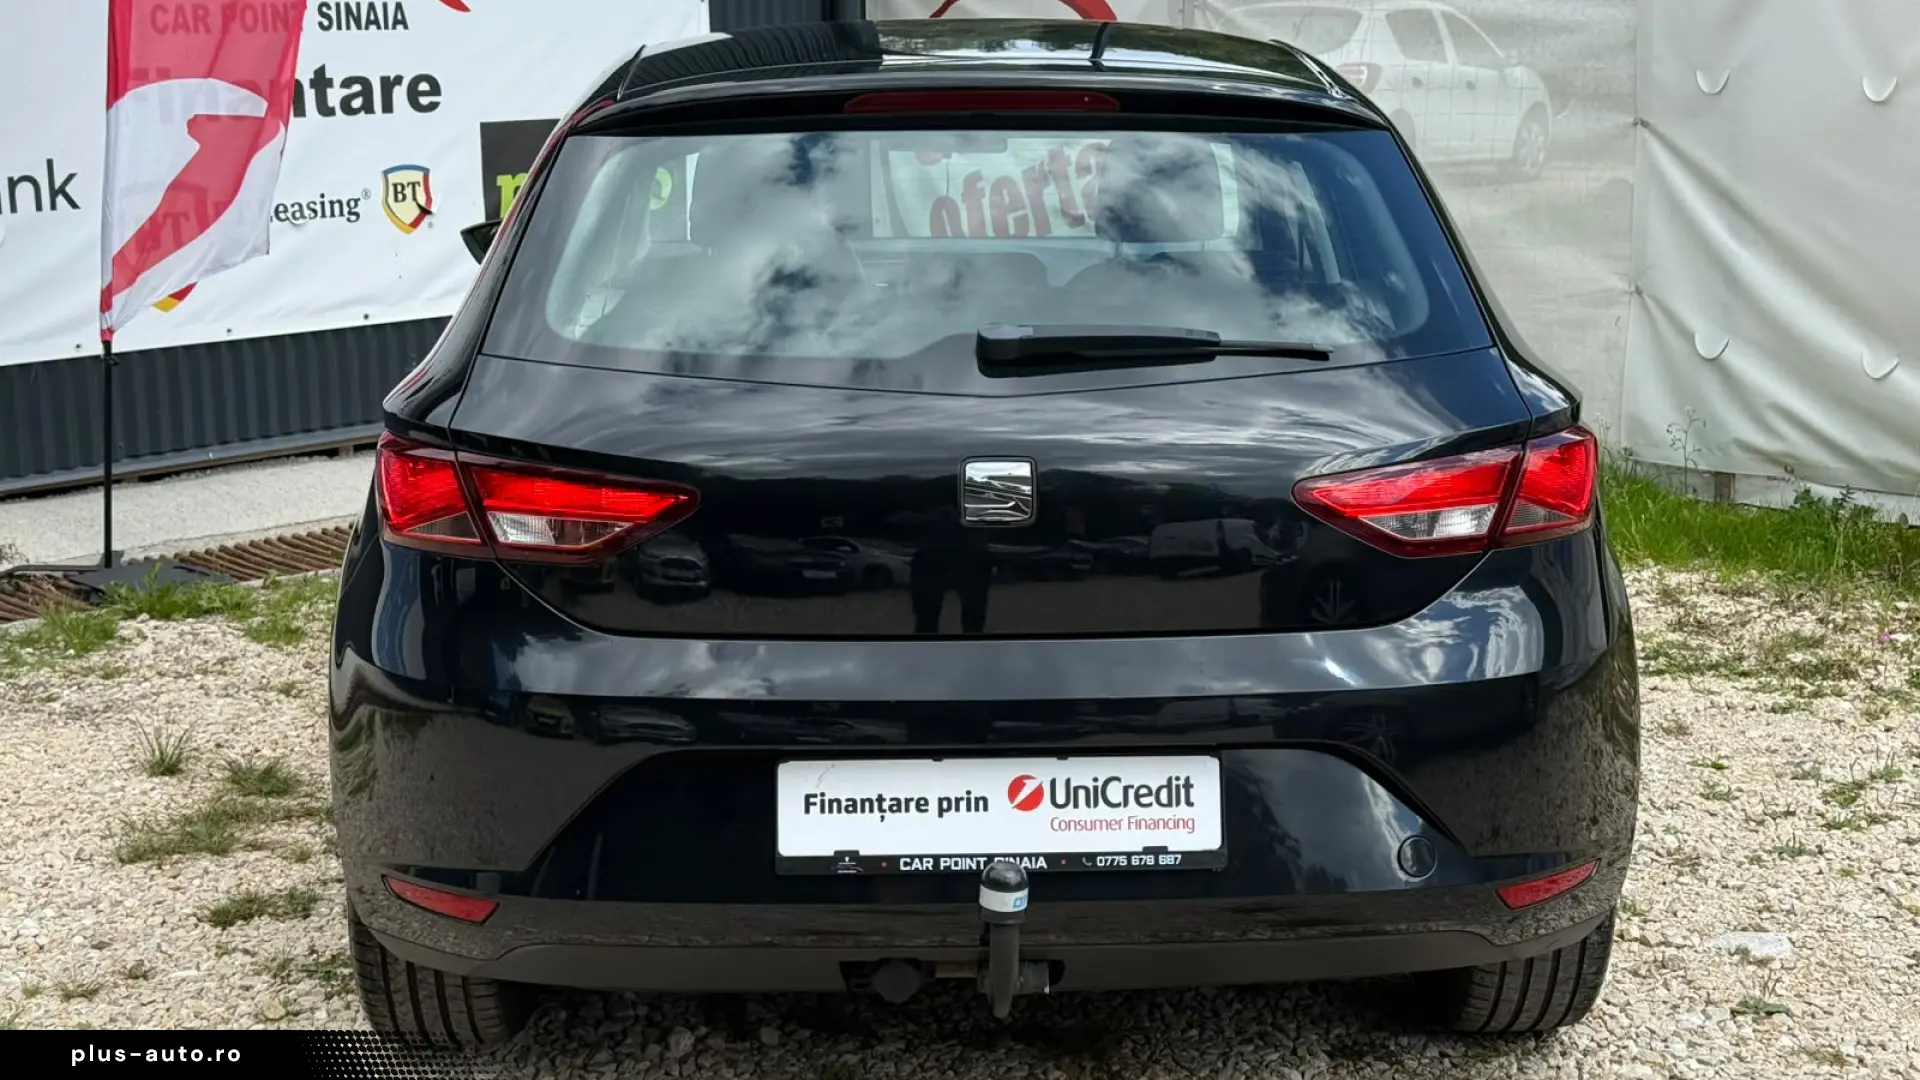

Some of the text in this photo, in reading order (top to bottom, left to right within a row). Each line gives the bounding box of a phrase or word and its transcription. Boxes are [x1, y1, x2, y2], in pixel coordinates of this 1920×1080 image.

[150, 4, 213, 35] CAR
[317, 1, 409, 31] SINAIA
[0, 158, 81, 215] nk
[392, 181, 421, 203] BT
[804, 775, 1195, 822] Finanțare prin UniCredit
[1050, 814, 1195, 834] Consumer Financing
[899, 857, 934, 871] CAR
[939, 857, 988, 870] POINT
[1096, 856, 1128, 866] 0775
[1130, 855, 1155, 866] 678
[1158, 854, 1182, 865] 687
